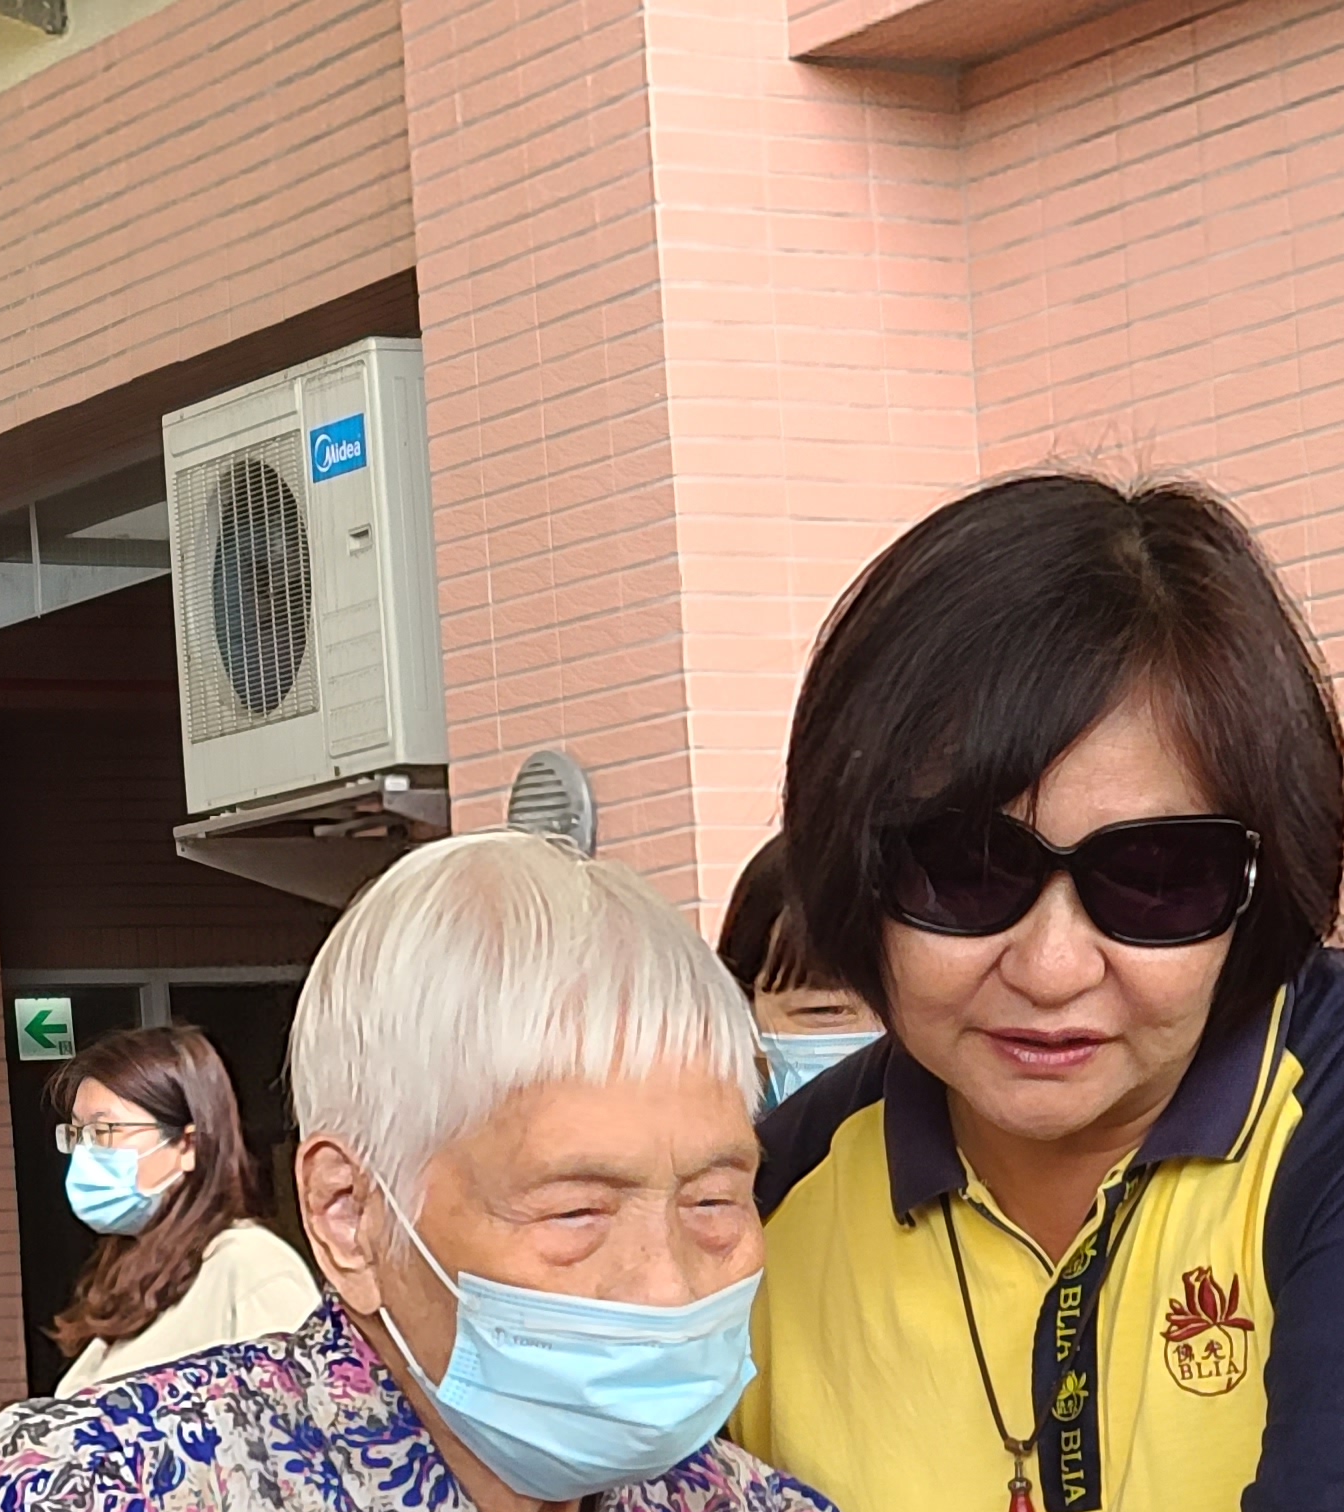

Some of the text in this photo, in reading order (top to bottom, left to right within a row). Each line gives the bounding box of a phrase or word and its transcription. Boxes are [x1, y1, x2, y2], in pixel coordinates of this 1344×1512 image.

[315, 434, 361, 473] Midea
[1178, 1360, 1241, 1380] BLIA
[1061, 1428, 1086, 1506] BLIA
